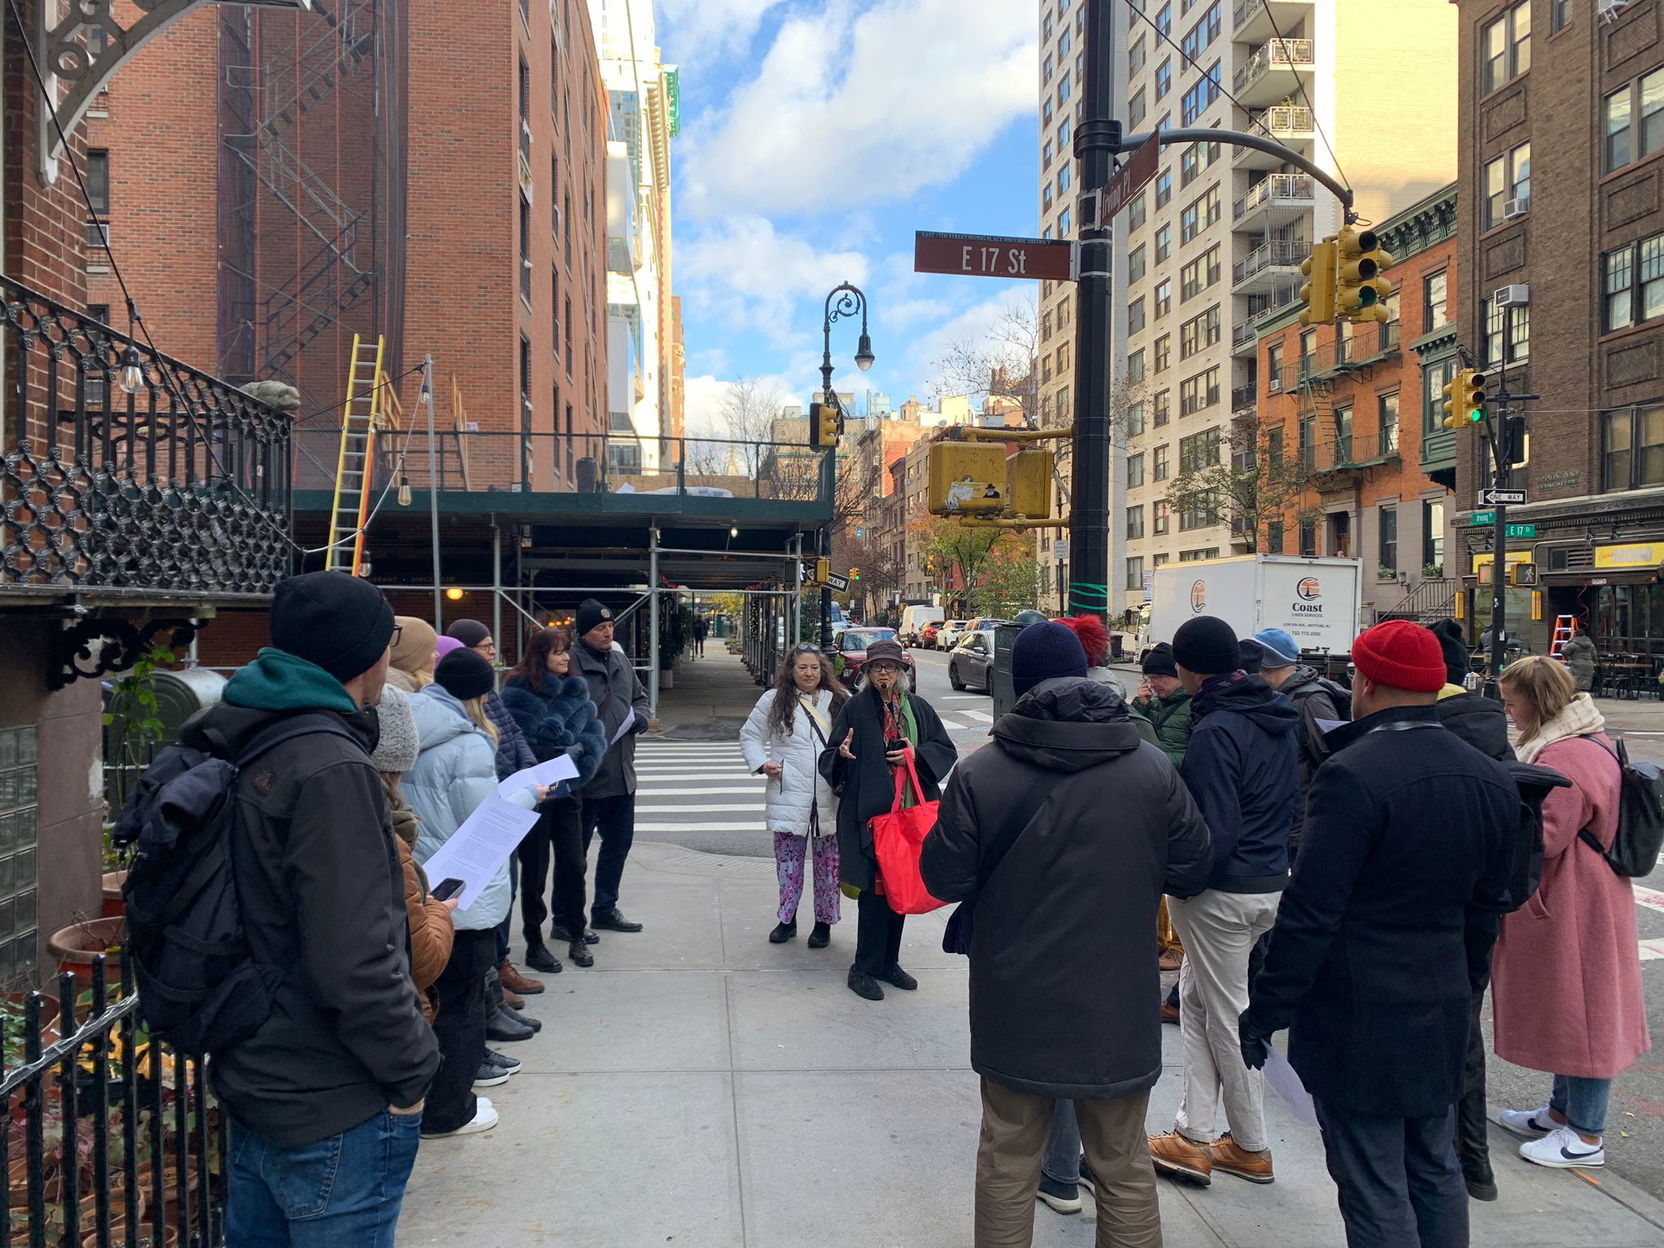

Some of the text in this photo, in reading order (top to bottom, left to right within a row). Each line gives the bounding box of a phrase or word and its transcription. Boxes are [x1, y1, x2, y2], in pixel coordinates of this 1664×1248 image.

[1123, 167, 1131, 198] Pl
[962, 245, 1026, 274] E 17 St
[1510, 526, 1515, 535] E
[1517, 526, 1524, 536] 17
[1292, 602, 1322, 612] Coast
